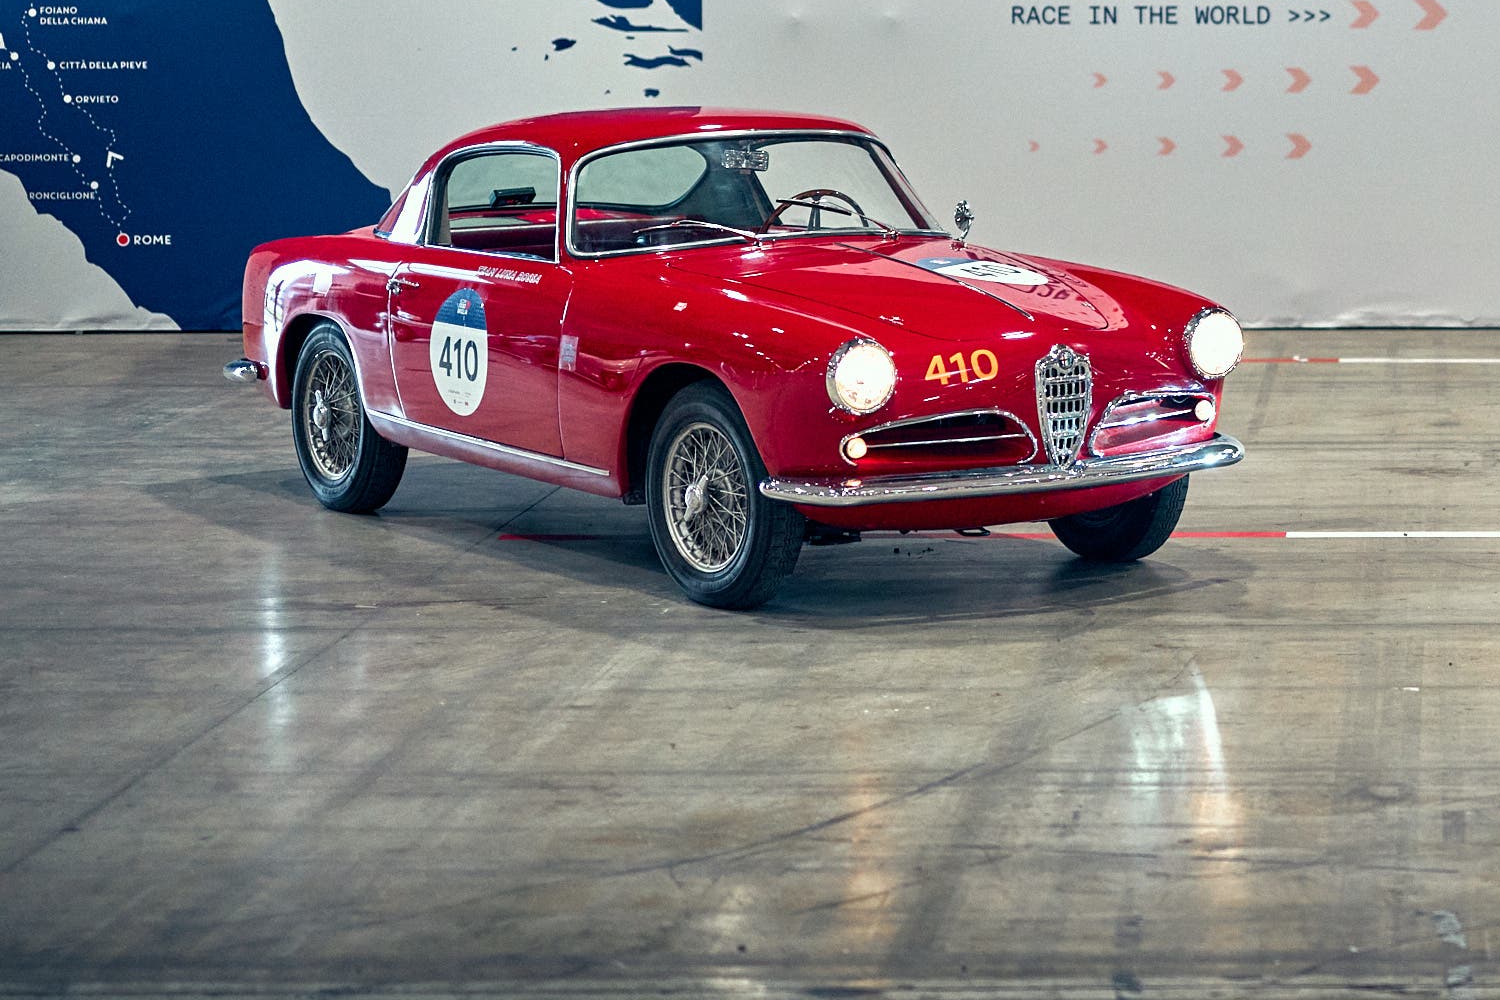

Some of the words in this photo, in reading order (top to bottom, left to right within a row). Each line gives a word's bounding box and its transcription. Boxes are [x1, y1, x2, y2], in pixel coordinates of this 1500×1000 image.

[40, 7, 78, 15] FOIANO
[1012, 6, 1070, 24] RACE
[1090, 6, 1117, 24] IN
[1134, 6, 1177, 24] THE
[1195, 6, 1270, 24] WORLD
[40, 17, 70, 26] DELLA
[71, 17, 108, 25] CHIANA
[60, 60, 87, 70] CITTÀ
[89, 61, 119, 70] DELLA
[121, 61, 148, 70] PIEVE
[76, 96, 119, 104] ORVIETO
[29, 192, 95, 200] RONCIGLIONE
[134, 235, 172, 246] ROME
[439, 336, 478, 382] 410
[924, 349, 999, 385] 410
